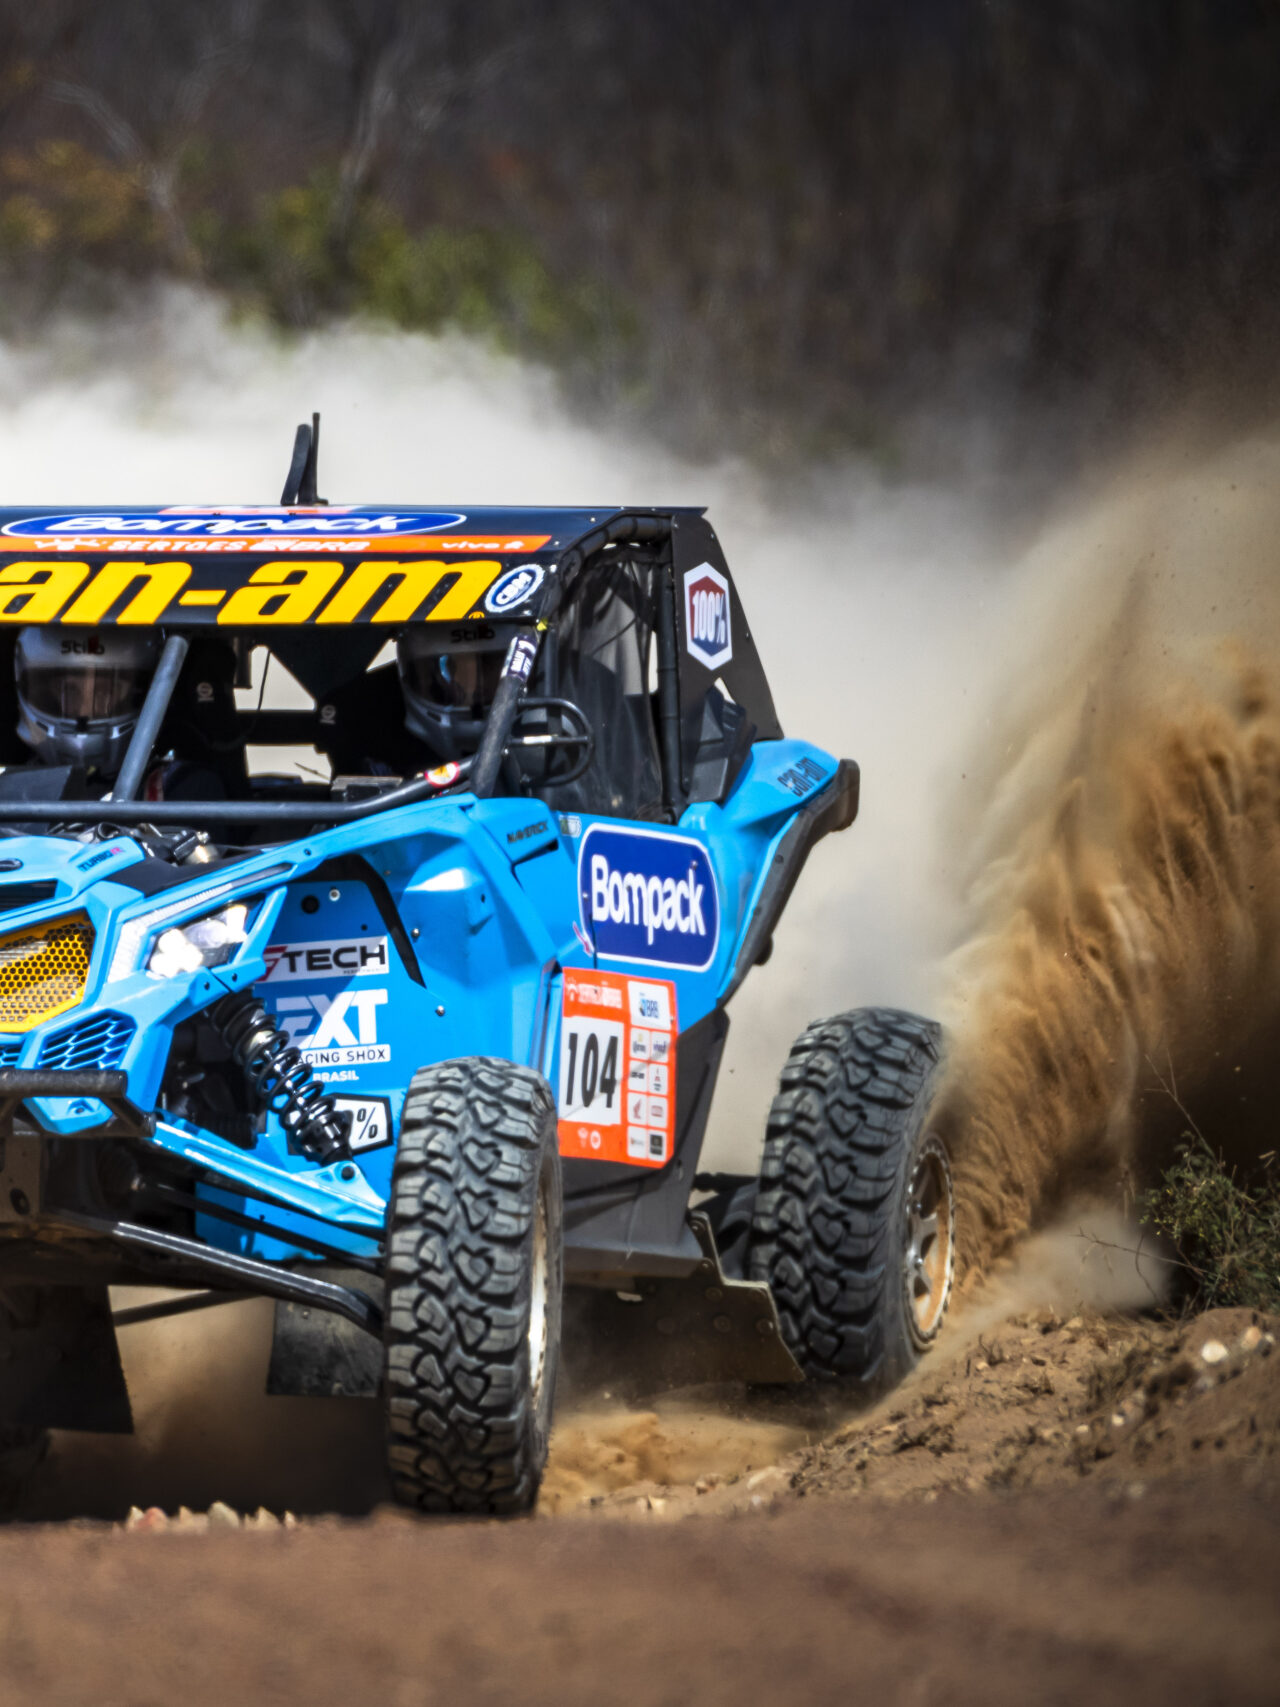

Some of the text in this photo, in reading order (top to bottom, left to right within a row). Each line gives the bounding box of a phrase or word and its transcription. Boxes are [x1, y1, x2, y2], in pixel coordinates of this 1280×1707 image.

[45, 516, 420, 534] Bompack
[692, 589, 728, 644] 100%
[591, 854, 706, 945] Bompack
[276, 988, 389, 1051] EXT
[297, 1049, 386, 1066] ACING SHOX
[312, 1069, 360, 1084] BRASIL
[565, 1032, 619, 1109] 104
